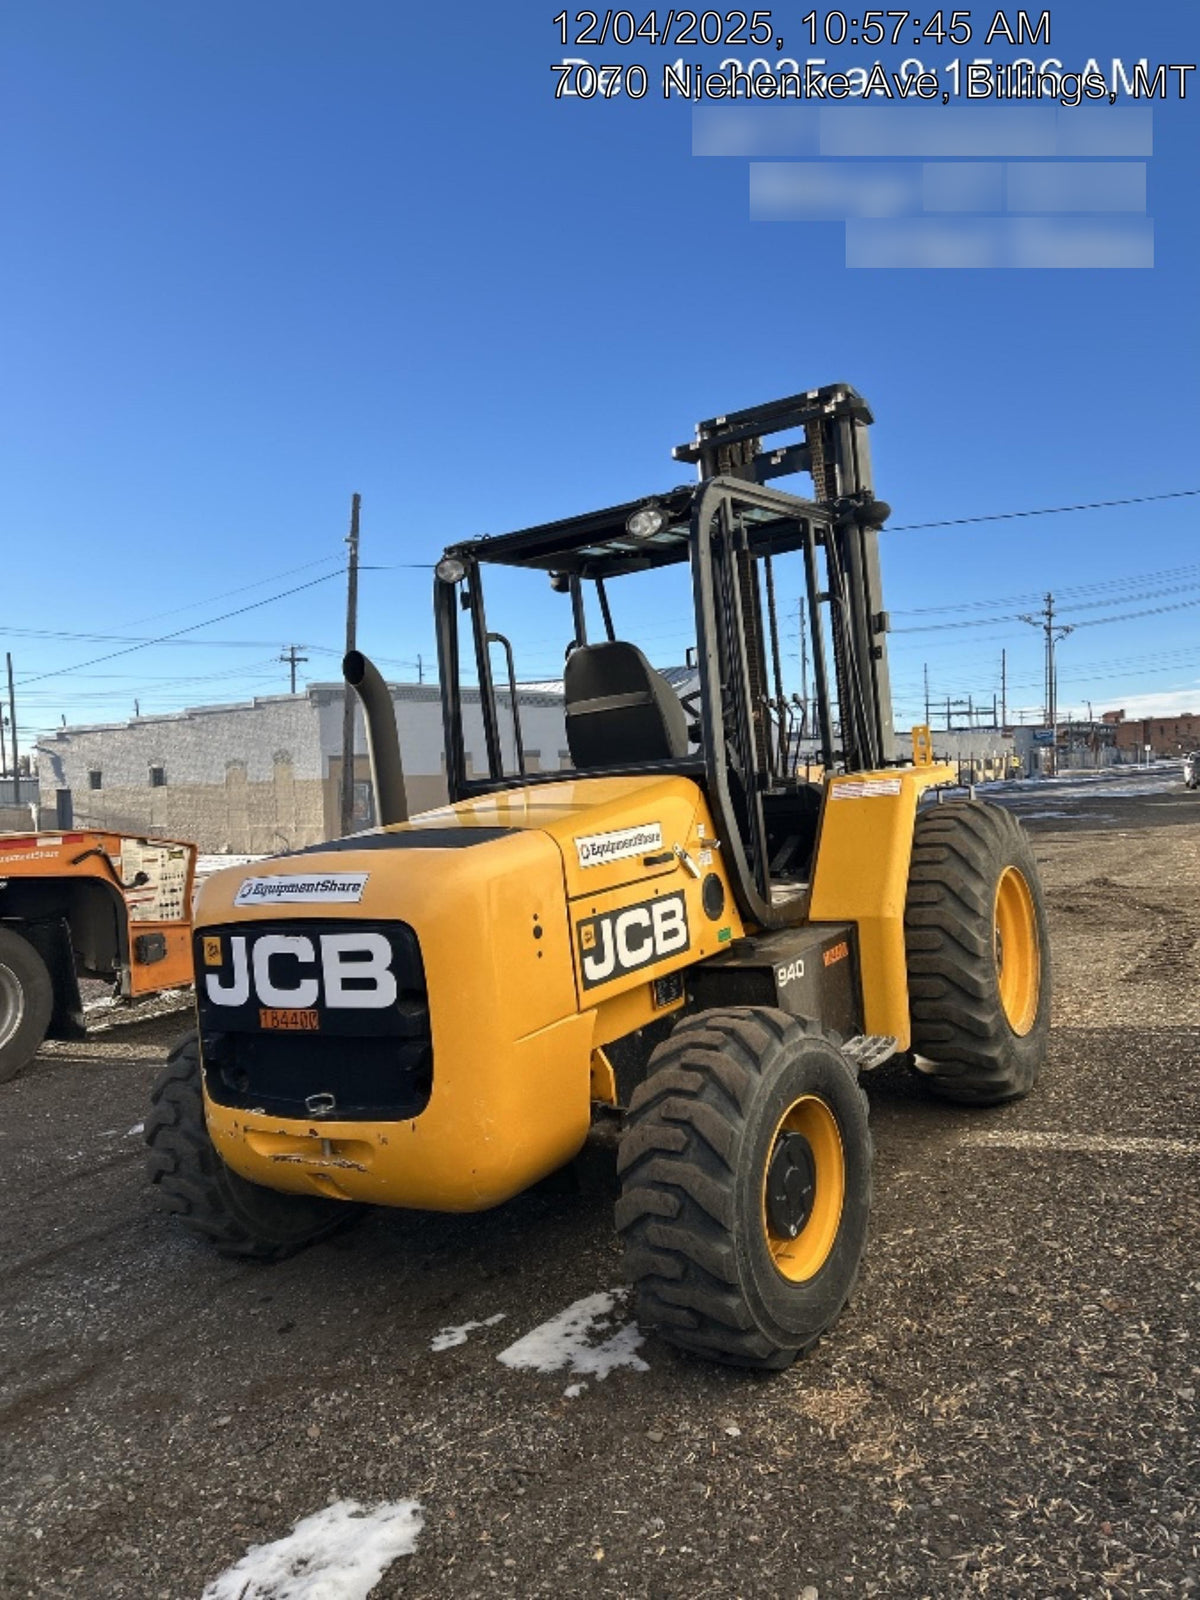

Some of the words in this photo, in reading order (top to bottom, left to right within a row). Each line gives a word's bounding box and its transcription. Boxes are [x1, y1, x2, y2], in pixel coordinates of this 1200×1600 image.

[252, 879, 361, 897] EquipmentShare
[583, 896, 688, 981] JCB
[205, 933, 397, 1009] JCB
[778, 959, 805, 988] 940
